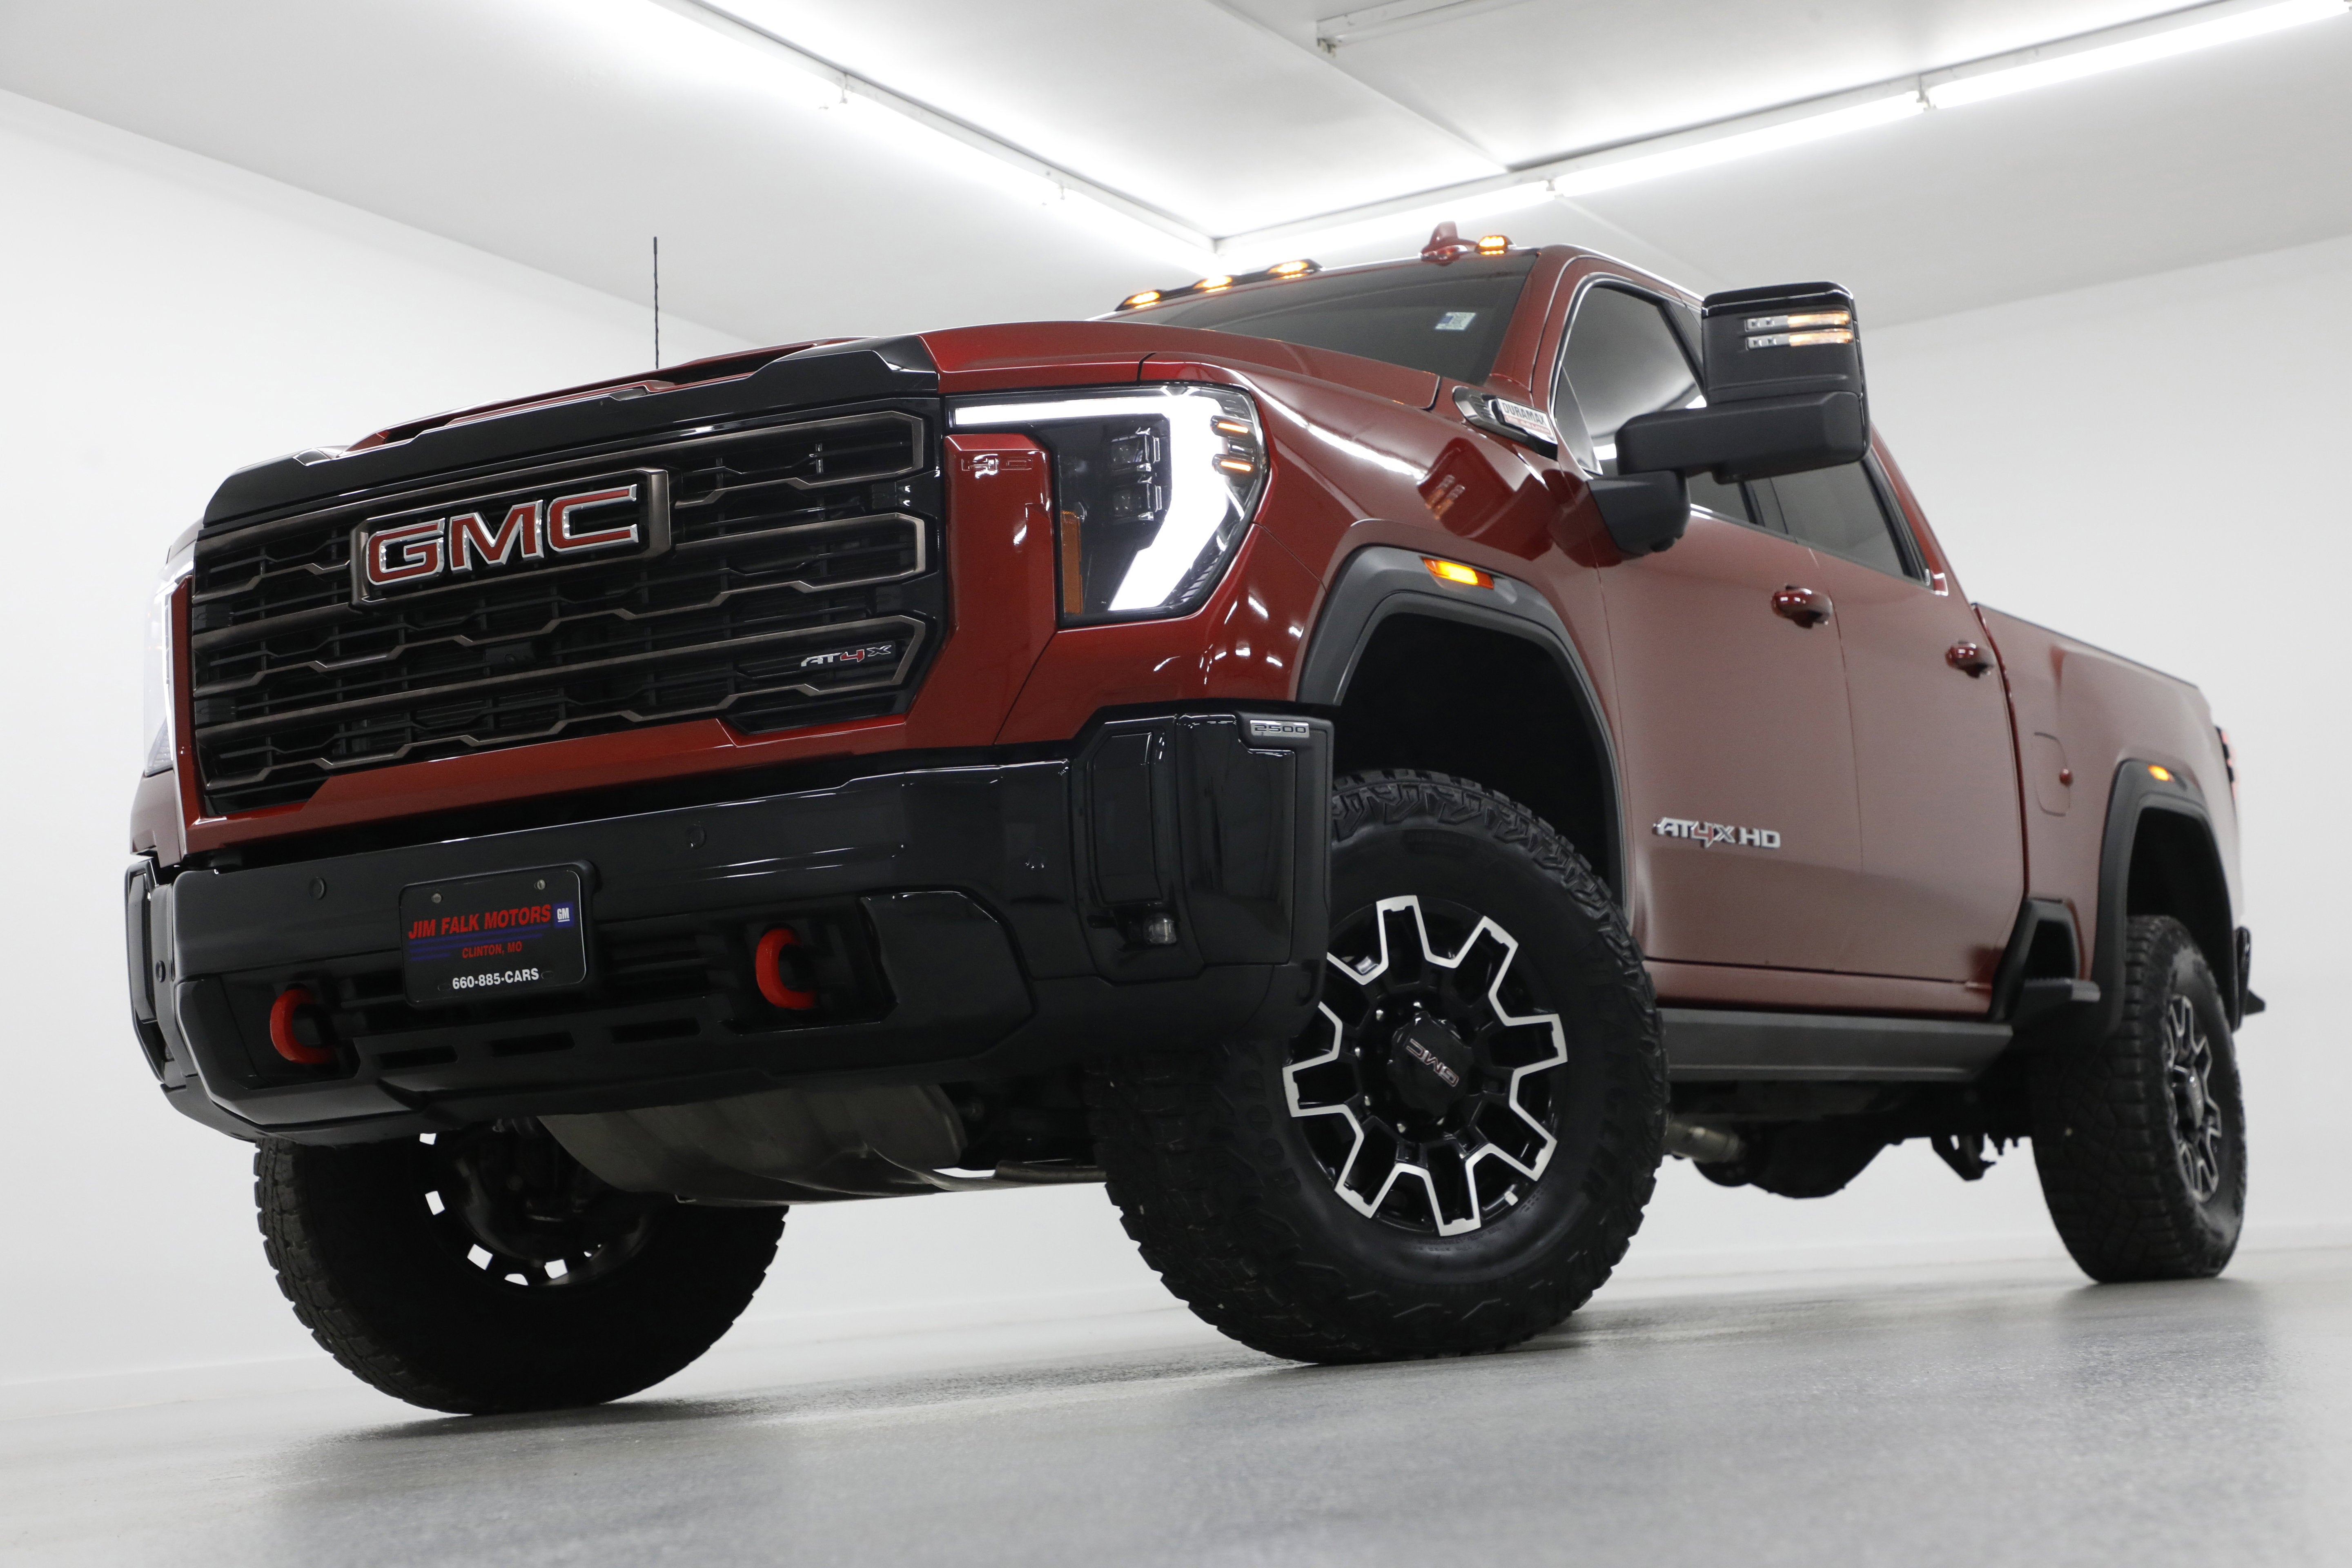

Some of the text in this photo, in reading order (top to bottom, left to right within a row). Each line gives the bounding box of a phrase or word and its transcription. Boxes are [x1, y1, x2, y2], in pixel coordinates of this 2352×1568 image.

[1501, 402, 1547, 426] DURAMAX
[366, 483, 639, 586] GMC
[800, 645, 892, 667] AT4X
[1254, 724, 1306, 733] 2500
[1654, 817, 1781, 849] AT4X HD
[408, 904, 552, 939] JIM FALK MOTORS
[557, 907, 570, 921] GM
[462, 941, 523, 959] CLINTON, MO
[452, 967, 539, 990] 660-885-CARS
[1406, 1038, 1459, 1087] GMC
